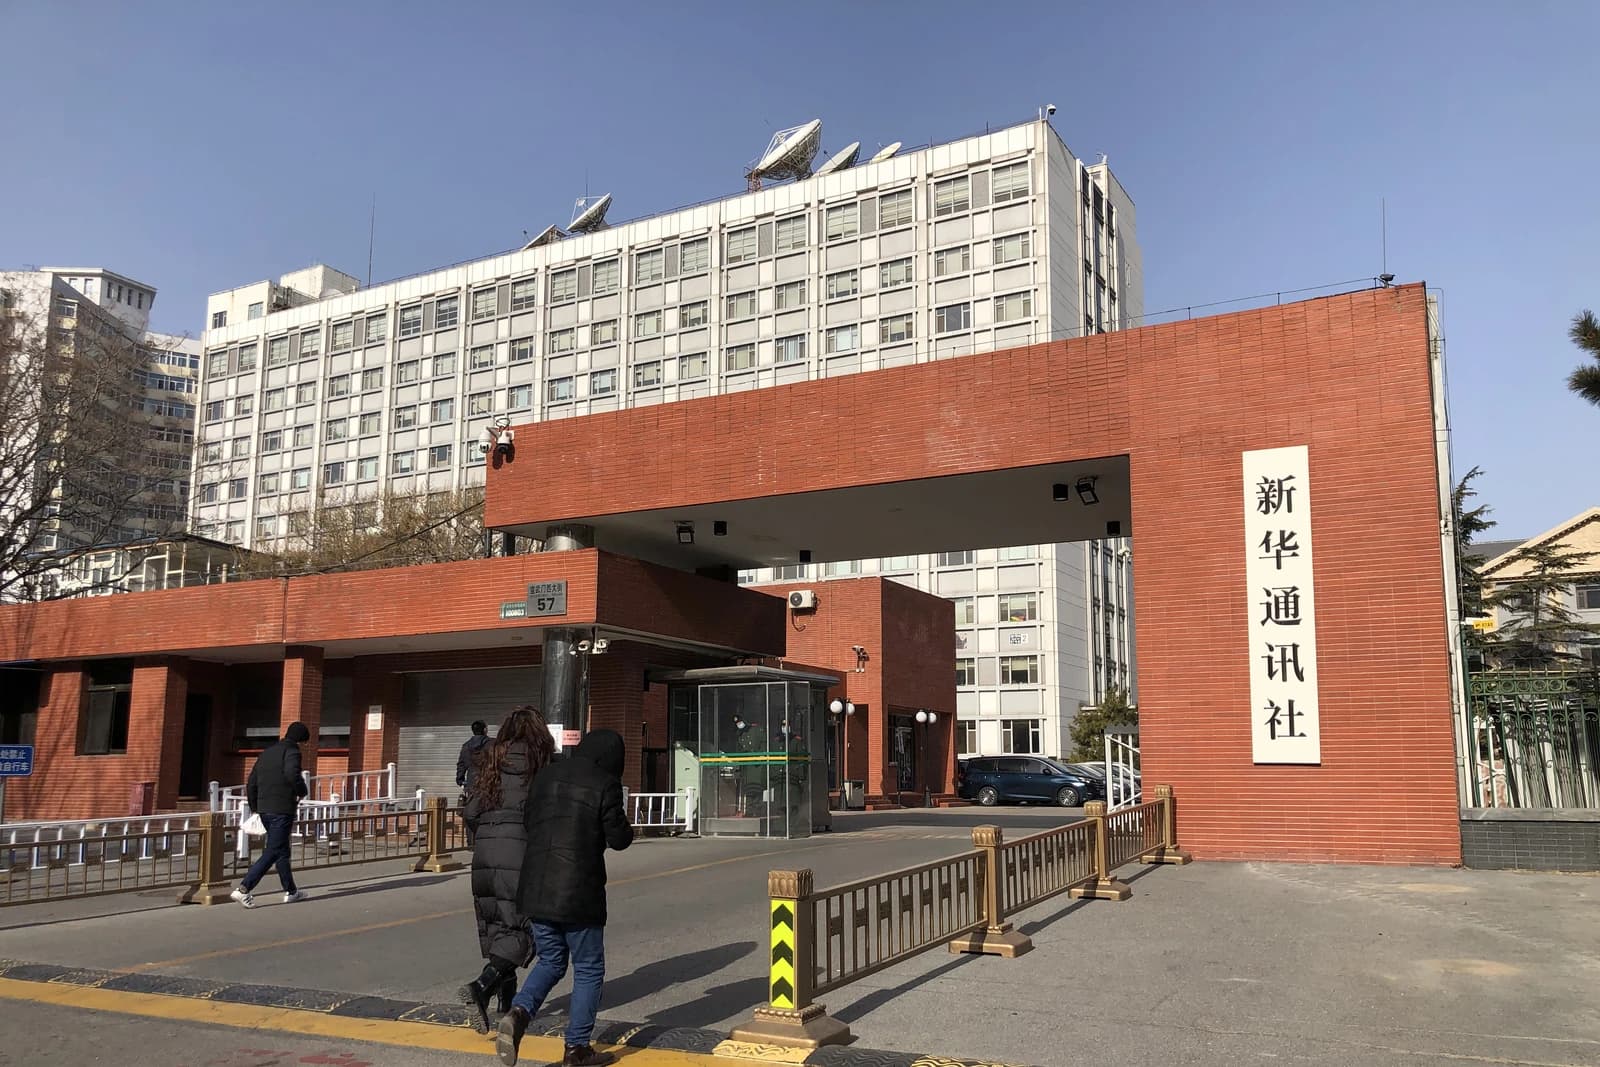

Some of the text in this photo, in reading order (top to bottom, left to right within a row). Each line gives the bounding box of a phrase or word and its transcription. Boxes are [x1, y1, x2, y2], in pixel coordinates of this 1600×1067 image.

[537, 597, 555, 611] 57
[1255, 474, 1308, 741] 新华通讯社
[0, 762, 30, 771] 自行车
